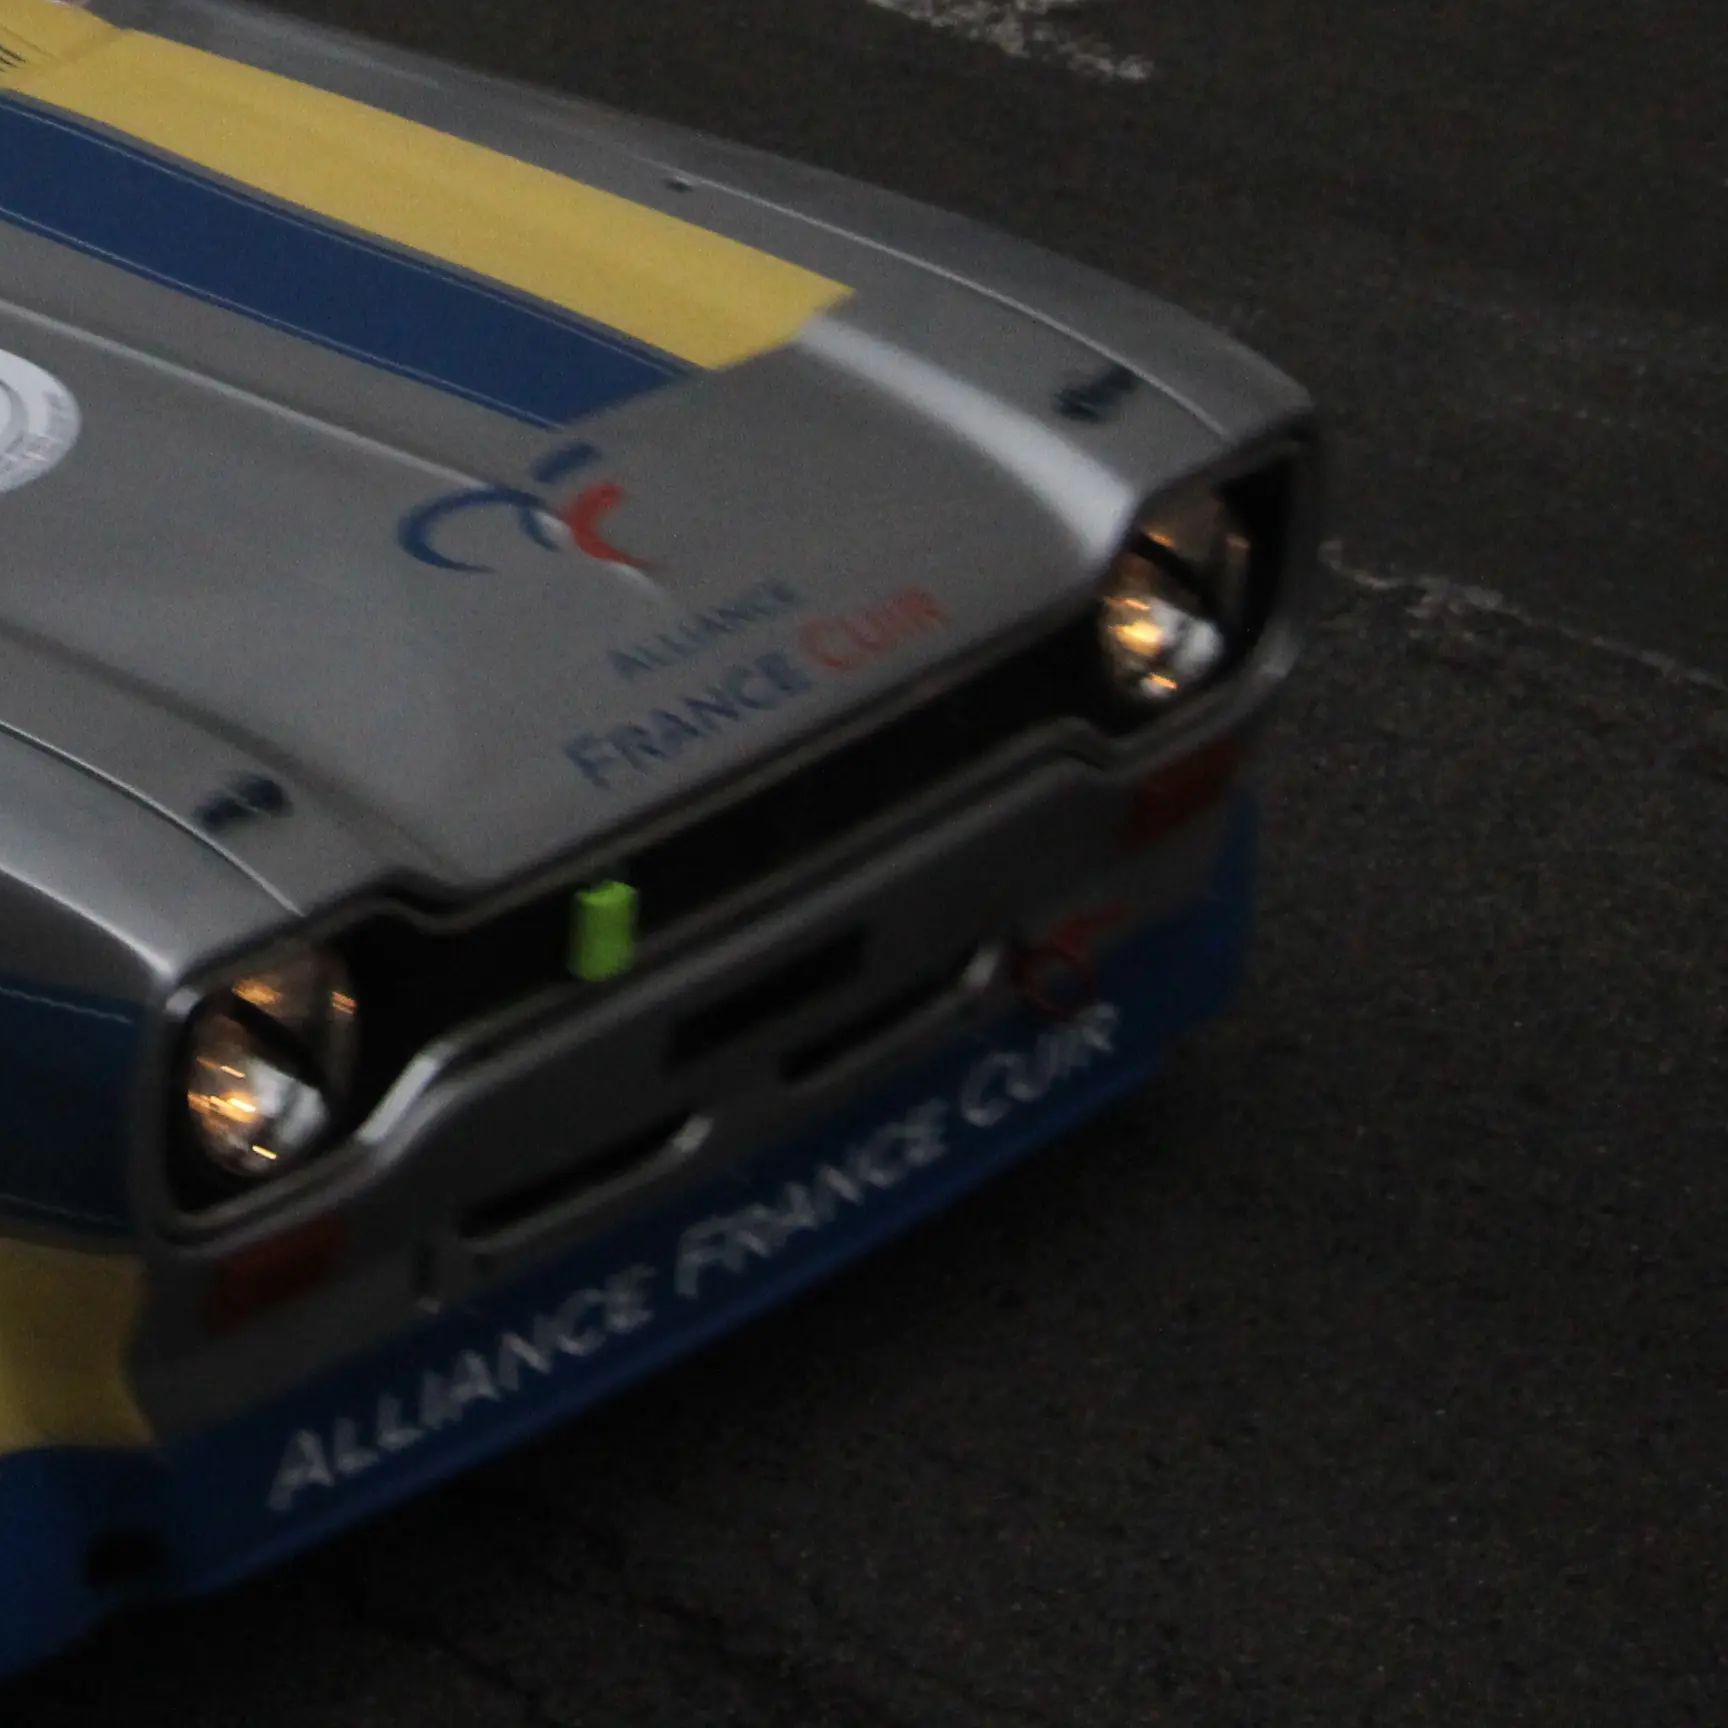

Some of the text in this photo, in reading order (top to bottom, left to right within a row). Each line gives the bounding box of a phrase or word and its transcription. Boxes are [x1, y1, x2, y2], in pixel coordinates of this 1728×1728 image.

[561, 585, 949, 790] FRANCE CUIR
[265, 999, 1123, 1514] ALLIANCE FRANCE CUIR
